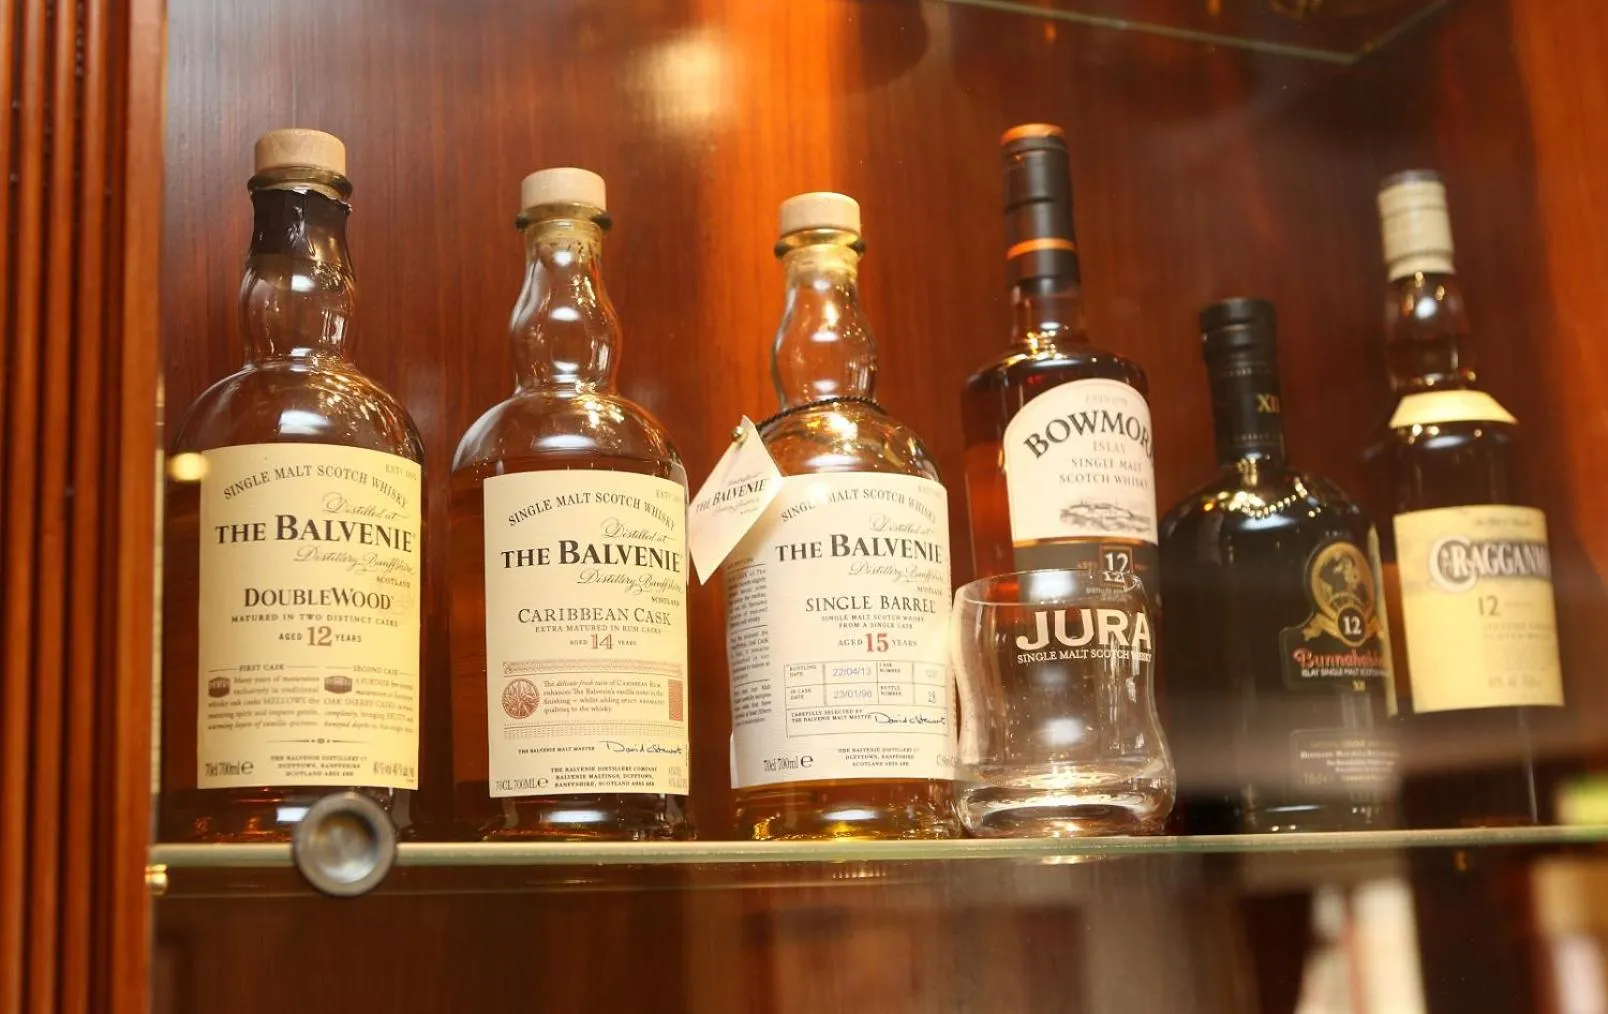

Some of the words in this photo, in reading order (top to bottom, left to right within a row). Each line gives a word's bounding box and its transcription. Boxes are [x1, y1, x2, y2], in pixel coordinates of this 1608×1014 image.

[1023, 410, 1152, 460] BOWMOR
[1093, 440, 1126, 454] ISLAY
[1071, 457, 1115, 469] SINGLE
[1119, 459, 1142, 472] MALT
[223, 471, 270, 501] SINGLE
[275, 464, 313, 481] MALT
[317, 466, 368, 486] SCOTCH
[371, 476, 409, 509] WHISKY
[1059, 473, 1110, 485] SCOTCH
[1113, 474, 1149, 490] WHISKY
[711, 478, 768, 507] BALVENIE
[508, 499, 553, 527] SINGLE
[556, 492, 592, 507] MALT
[595, 491, 641, 510] SCOTCH
[644, 501, 677, 532] WHISKY
[781, 500, 820, 523] SINGL
[827, 488, 860, 504] MALT
[863, 487, 906, 505] SCOTCH
[214, 522, 266, 545] THE
[275, 514, 412, 553] BALVENIE
[501, 548, 550, 569] THE
[558, 539, 681, 573] BALVENIE
[775, 542, 823, 562] THE
[830, 533, 943, 564] BALVENIE
[1103, 552, 1130, 580] 12
[805, 596, 874, 612] SINGLE
[880, 595, 936, 614] BARREL
[1478, 595, 1499, 616] 12
[231, 612, 280, 624] MATURED
[282, 612, 295, 622] IN
[299, 612, 323, 622] TWO
[326, 613, 372, 625] DISTINCT
[518, 607, 629, 624] CARIBBEAN
[634, 607, 672, 626] CASK
[821, 614, 848, 622] SINGLE
[850, 614, 871, 622] MALT
[873, 614, 901, 622] SCOTCH
[838, 622, 858, 630] FROM
[1342, 616, 1362, 635] 12
[278, 632, 303, 642] AGED
[307, 625, 333, 647] 12
[335, 633, 362, 643] YEARS
[535, 625, 563, 633] EXTRA
[566, 624, 608, 632] MATURED
[610, 624, 620, 632] IN
[1015, 608, 1152, 650] JURA
[569, 639, 589, 647] AGED
[590, 633, 615, 650] 14
[617, 639, 637, 647] YEARS
[837, 638, 863, 647] AGED
[864, 632, 889, 654] 15
[892, 638, 918, 647] YEARS
[1016, 651, 1058, 664] SINGLE
[1059, 649, 1089, 660] MALT
[1090, 648, 1130, 660] SCOTCH
